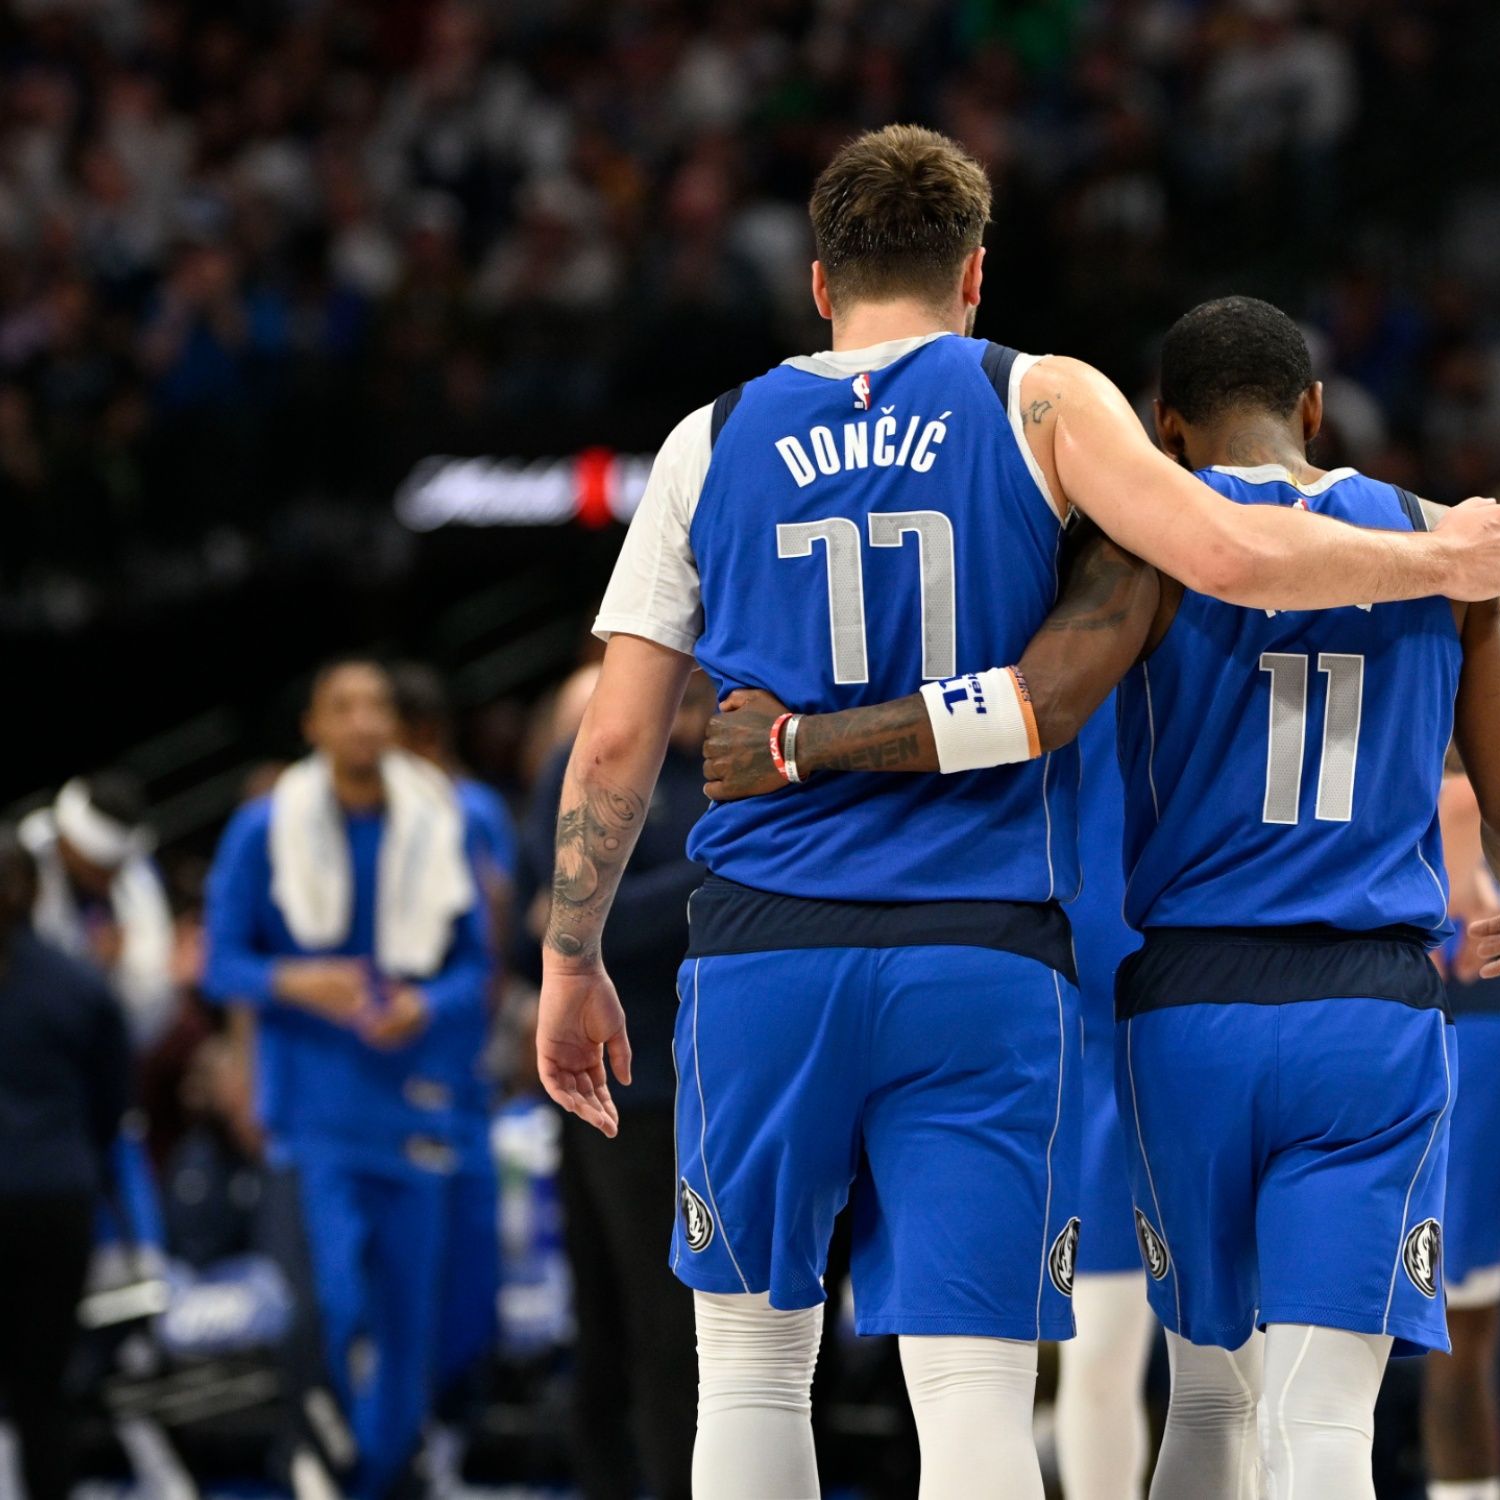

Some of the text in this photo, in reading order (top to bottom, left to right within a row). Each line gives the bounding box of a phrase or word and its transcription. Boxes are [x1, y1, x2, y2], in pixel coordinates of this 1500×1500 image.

[775, 404, 952, 488] DONČIĆ
[776, 510, 957, 684] 77
[1259, 652, 1365, 825] 11
